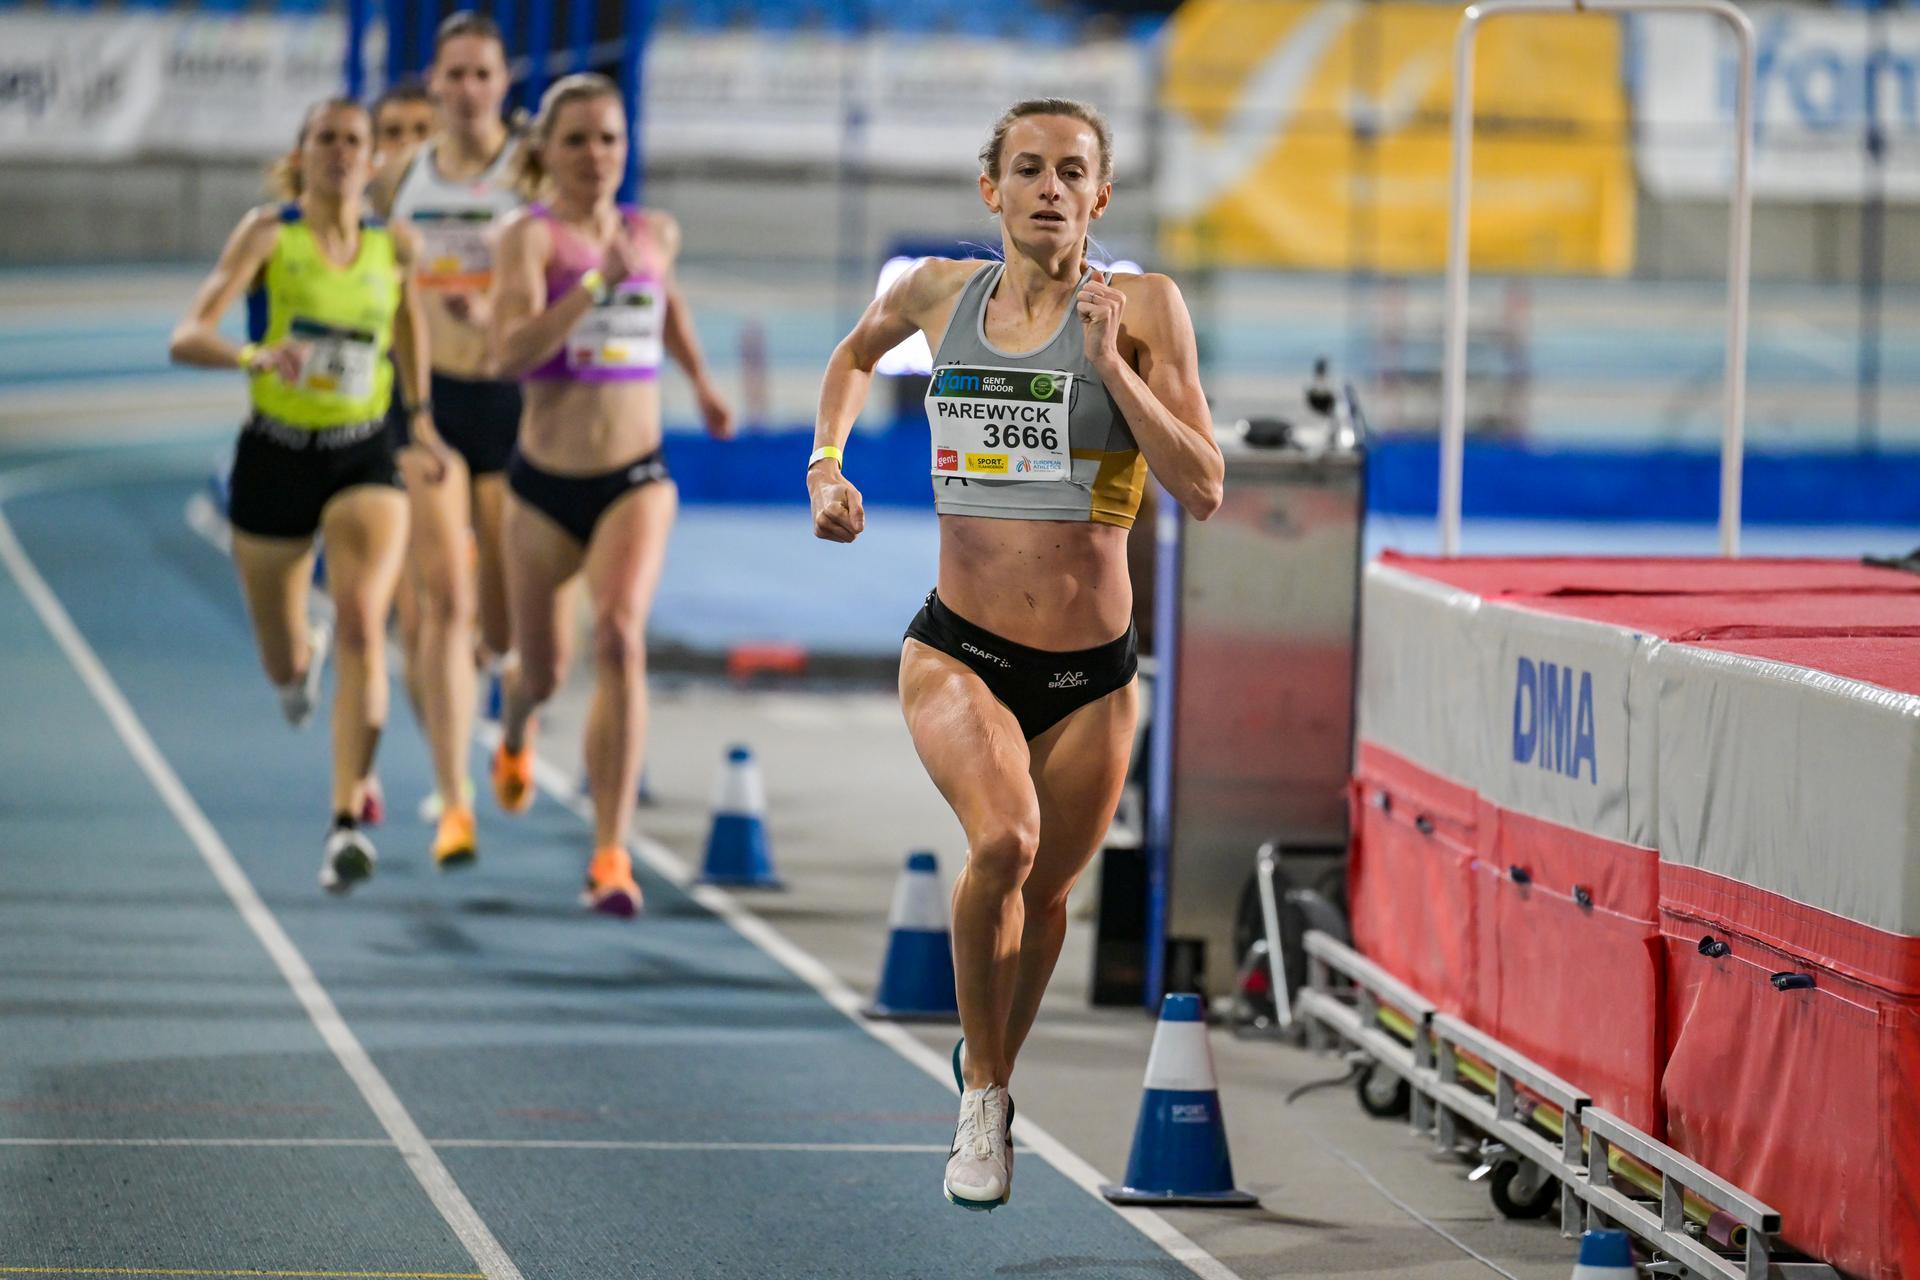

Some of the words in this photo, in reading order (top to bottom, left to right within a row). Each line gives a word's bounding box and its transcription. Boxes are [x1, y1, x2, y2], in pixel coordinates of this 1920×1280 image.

[982, 384, 1014, 393] INDOOR
[983, 376, 1006, 386] GENT
[938, 402, 1051, 423] PAREWYCK
[983, 423, 1058, 450] 3666
[937, 454, 957, 467] gent:
[961, 642, 1001, 663] CRAFT
[1512, 656, 1597, 786] DIMA
